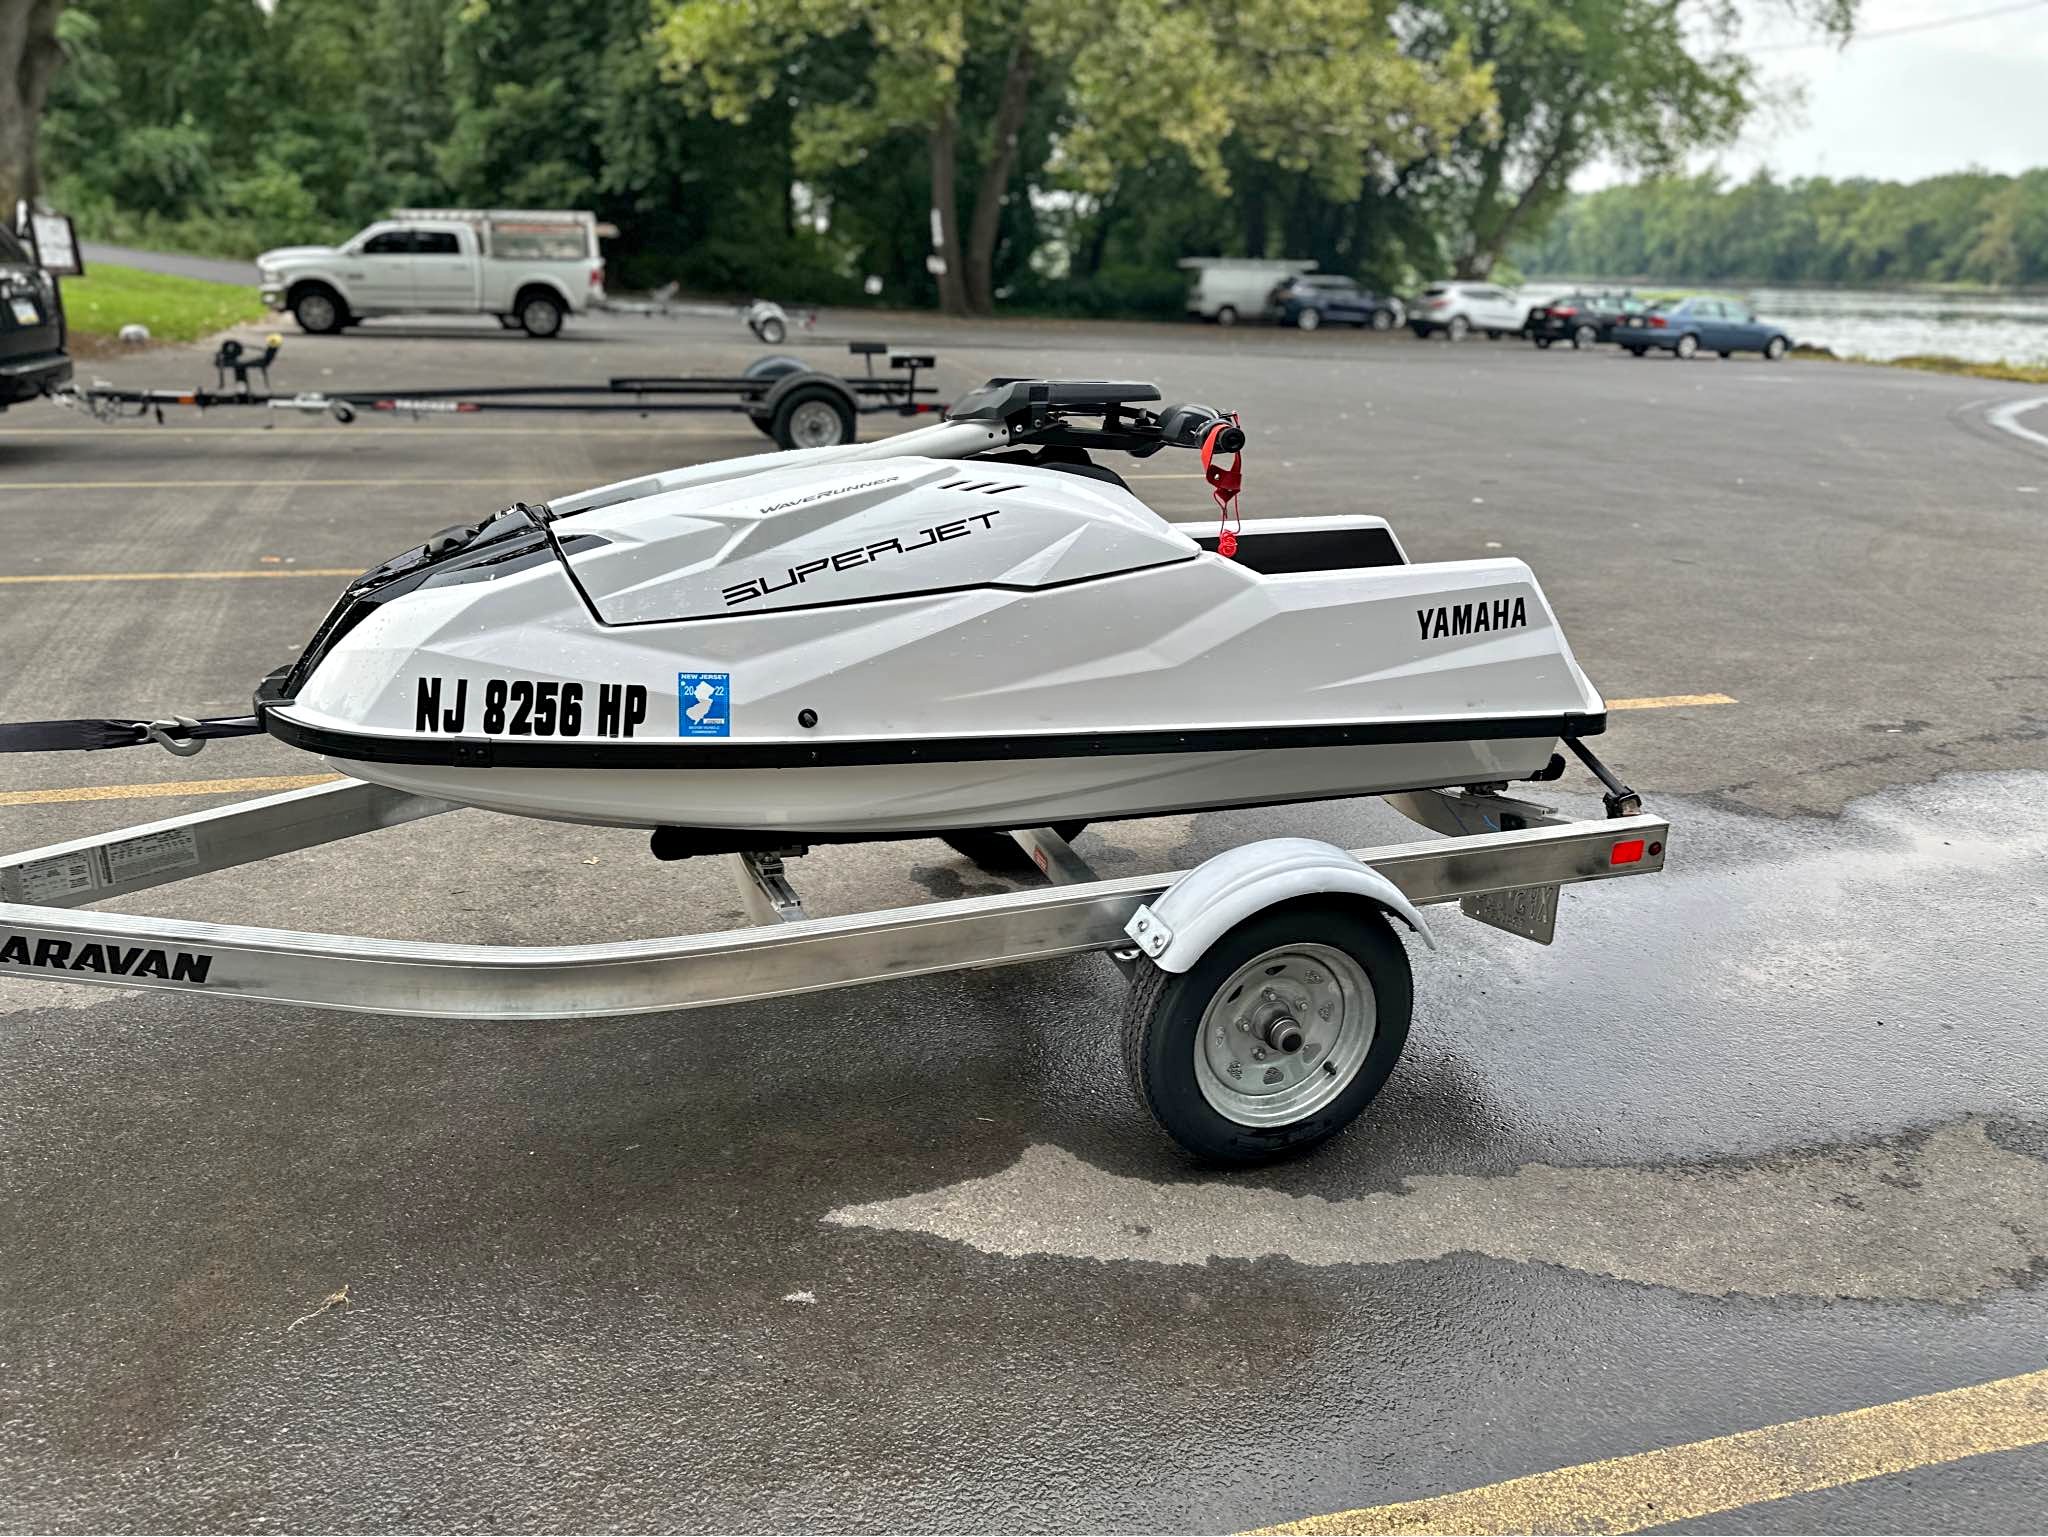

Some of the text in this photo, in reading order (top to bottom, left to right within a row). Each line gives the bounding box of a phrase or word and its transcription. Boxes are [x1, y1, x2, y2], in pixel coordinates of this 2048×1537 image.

[759, 475, 899, 515] WAVERUNNER
[721, 510, 1000, 607] SUPERJET
[1417, 597, 1527, 640] YAMAHA
[416, 677, 647, 738] NJ 8256 HP
[684, 685, 725, 696] 20 22
[0, 935, 213, 984] ARAVAN
